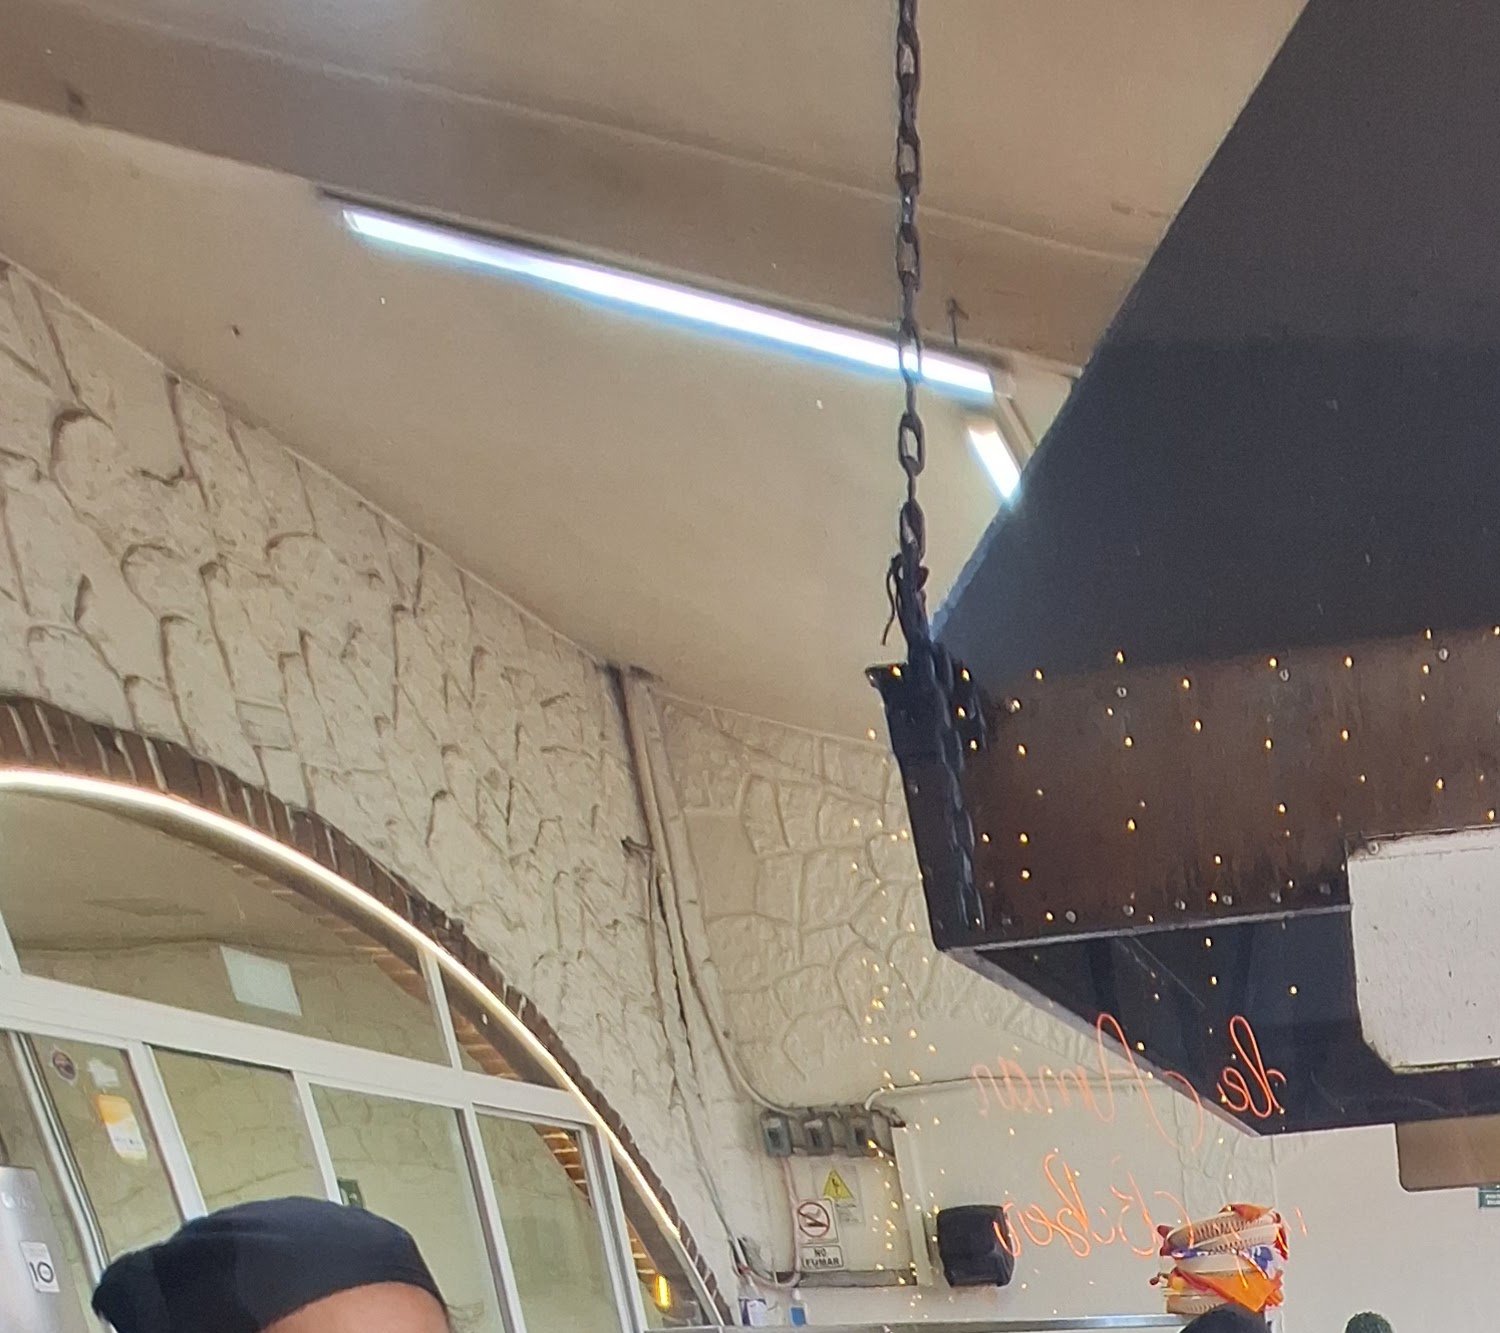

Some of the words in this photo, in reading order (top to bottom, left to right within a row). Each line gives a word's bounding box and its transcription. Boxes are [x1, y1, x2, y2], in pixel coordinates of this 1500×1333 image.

[813, 1247, 828, 1258] NO
[804, 1257, 840, 1267] FUMAR
[29, 1260, 54, 1284] 10
